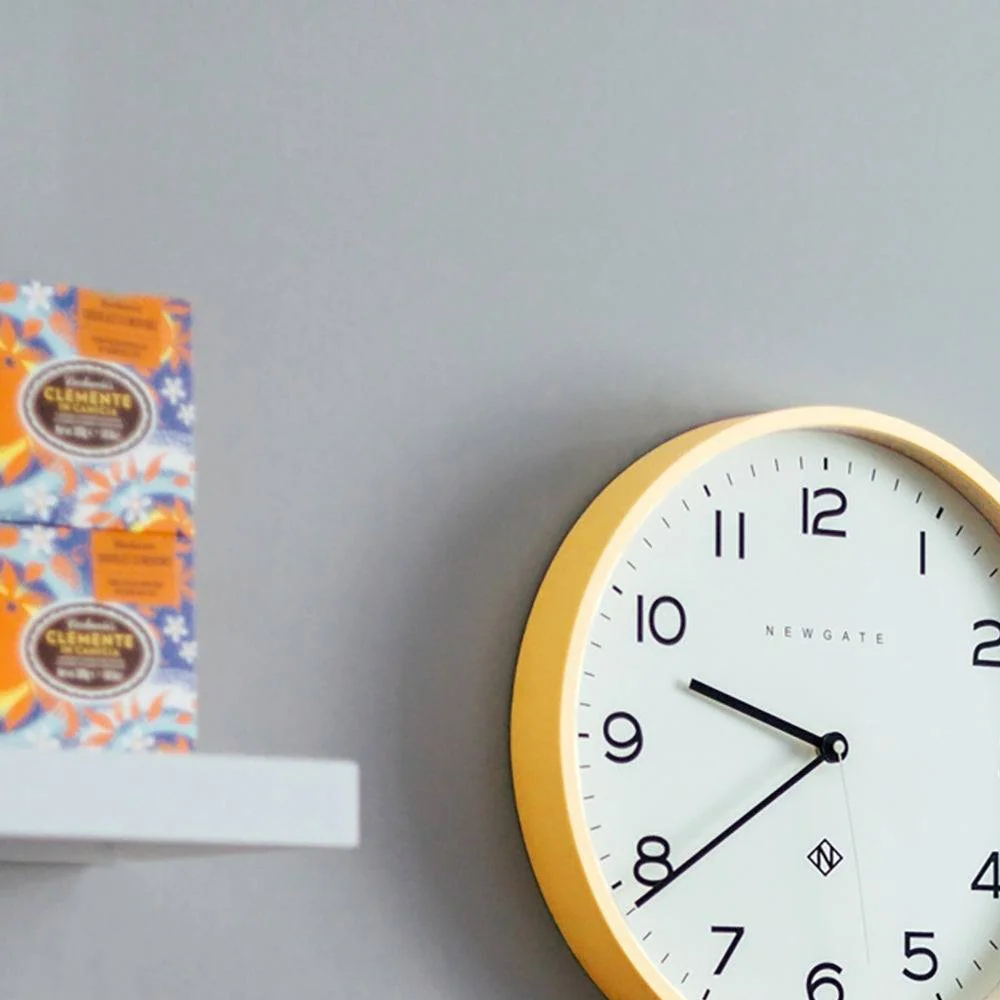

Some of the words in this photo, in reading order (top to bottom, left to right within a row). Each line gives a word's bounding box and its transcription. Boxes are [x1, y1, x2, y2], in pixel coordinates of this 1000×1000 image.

[44, 385, 133, 411] CLEMENTE
[713, 509, 745, 560] 11
[801, 485, 848, 538] 12
[918, 530, 927, 576] 1
[46, 629, 134, 651] CLEMENTE
[635, 594, 688, 646] 10
[765, 624, 884, 645] NEWGATE
[602, 711, 644, 763] 9
[632, 834, 675, 887] 8
[710, 925, 745, 976] 7
[902, 931, 939, 982] 5
